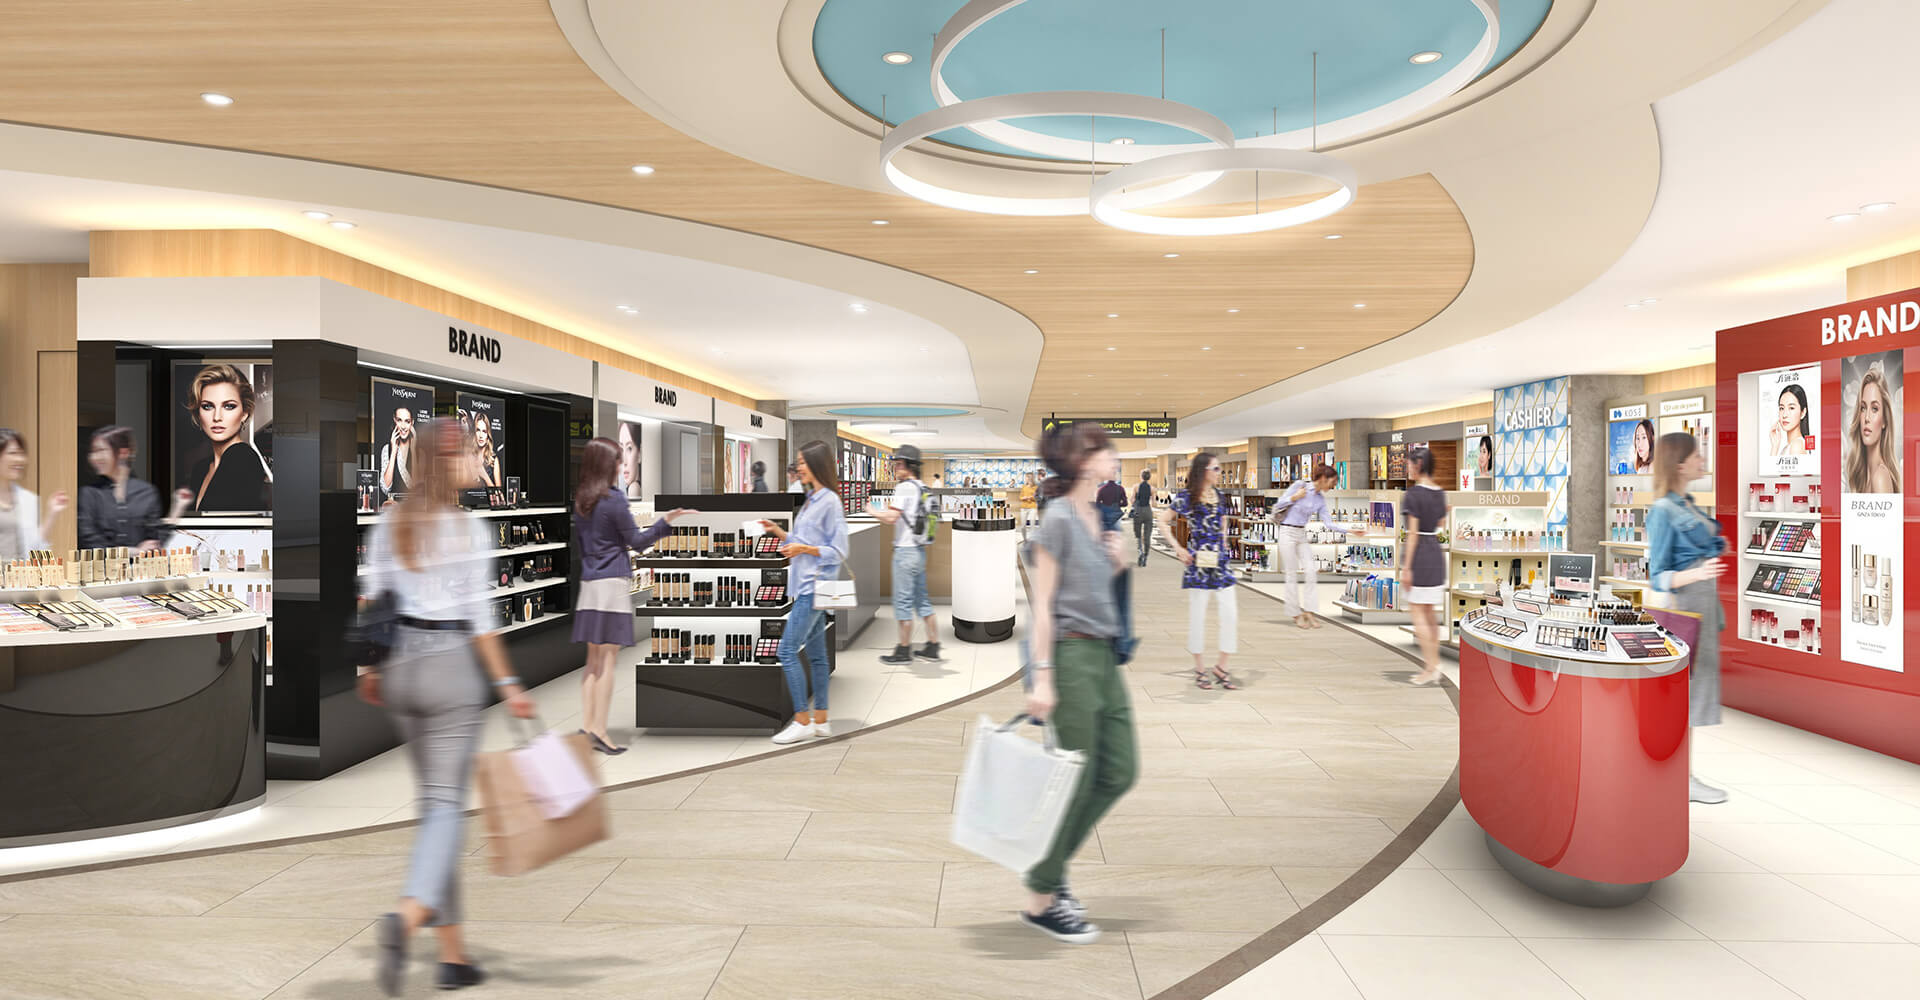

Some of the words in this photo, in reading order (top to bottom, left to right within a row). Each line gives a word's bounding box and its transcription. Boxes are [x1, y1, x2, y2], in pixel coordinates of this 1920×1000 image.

[1821, 301, 1920, 346] BRAND
[449, 326, 501, 363] BRAND
[654, 386, 677, 407] BRAND
[1148, 422, 1170, 430] Lounge
[1505, 407, 1553, 430] CASHIER
[1479, 494, 1521, 505] BRAND
[1851, 500, 1893, 511] BRAND
